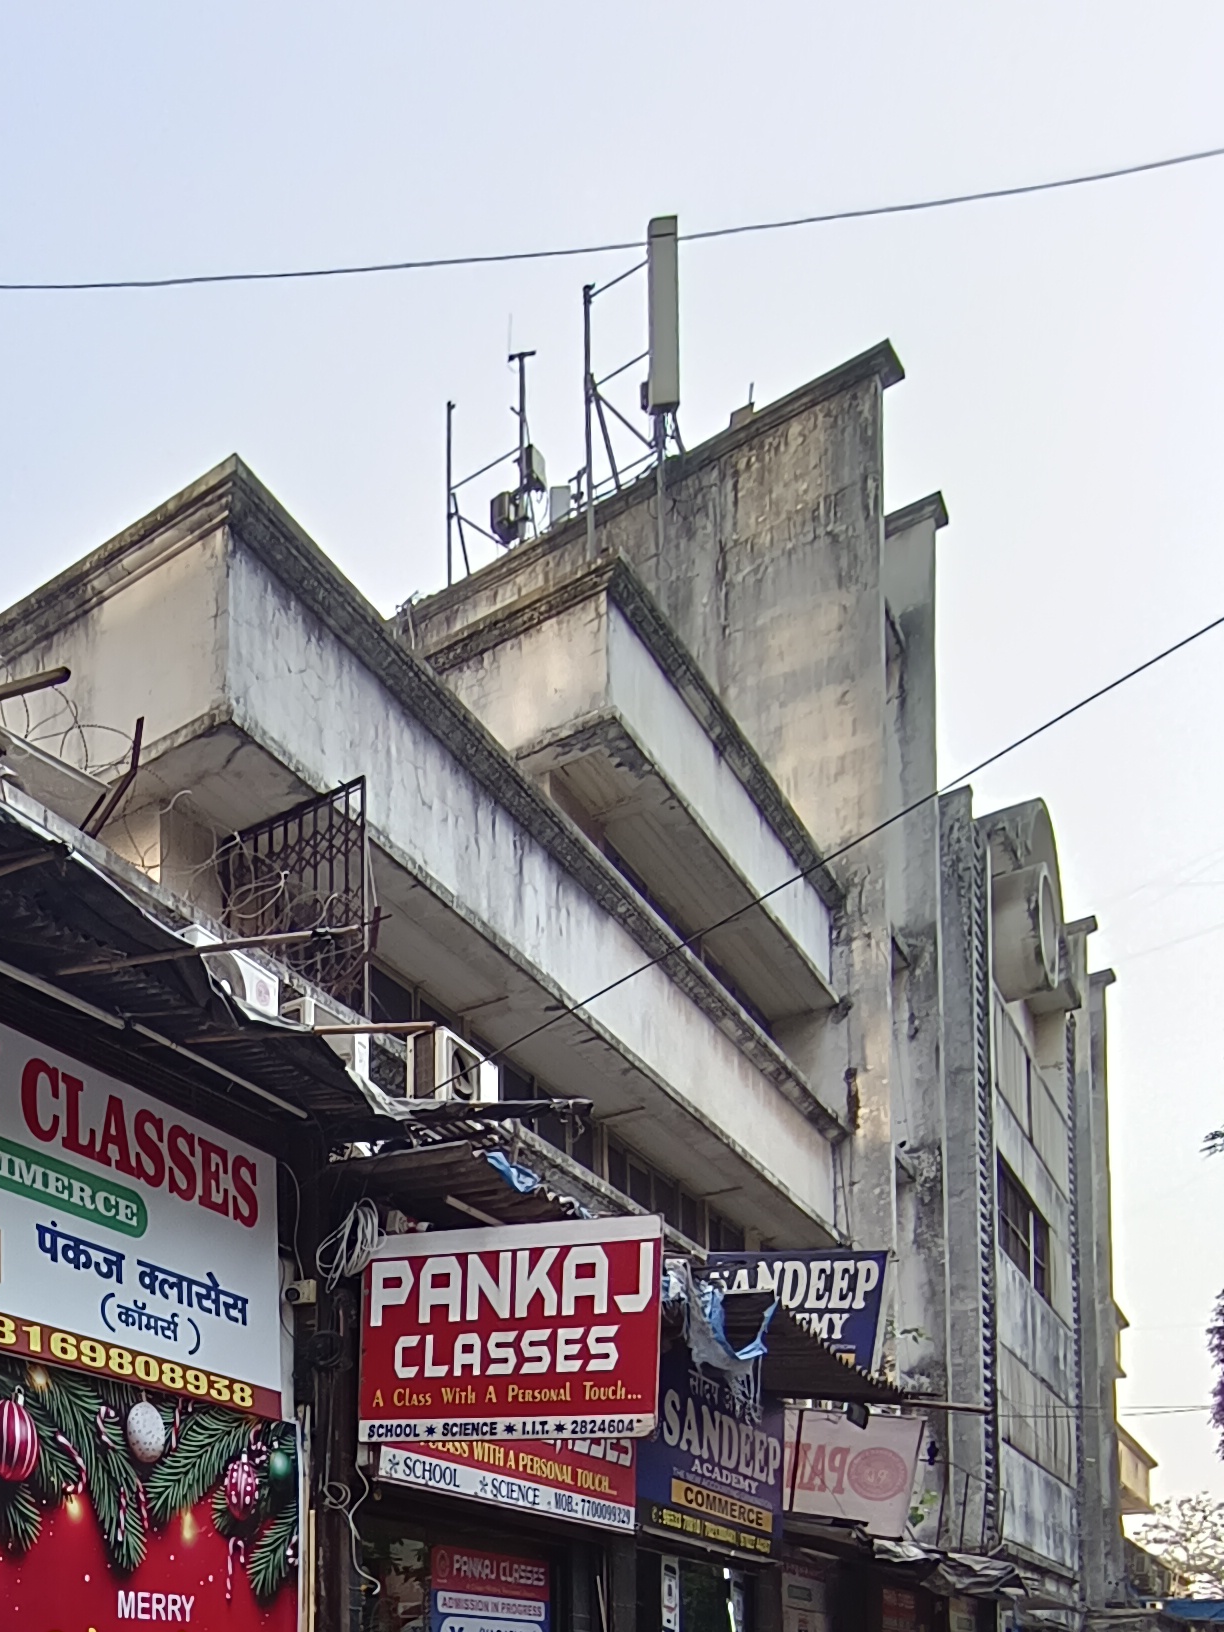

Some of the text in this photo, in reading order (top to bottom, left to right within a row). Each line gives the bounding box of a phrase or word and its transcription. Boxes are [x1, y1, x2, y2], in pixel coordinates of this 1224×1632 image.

[21, 1058, 259, 1228] CLASSES
[35, 1220, 249, 1327] पंकज क्लासेस
[370, 1241, 654, 1327] PANKAJ
[394, 1324, 621, 1379] CLASSES
[372, 1389, 383, 1408] A
[485, 1385, 497, 1403] A
[368, 1423, 421, 1439] SCHOOL
[442, 1421, 498, 1437] SCIENCE
[571, 1419, 643, 1436] 2824604
[663, 1388, 782, 1486] SANDEEP
[403, 1456, 460, 1489] SCHOOL
[490, 1477, 541, 1507] SCIENCE
[474, 1440, 505, 1467] WITH
[507, 1450, 516, 1470] A
[519, 1456, 575, 1486] PERSONAL
[691, 1458, 759, 1494] ACADEMY
[684, 1486, 764, 1527] COMMERCE
[453, 1554, 545, 1587] PANKAJ CLASSES
[117, 1589, 195, 1622] MERRY
